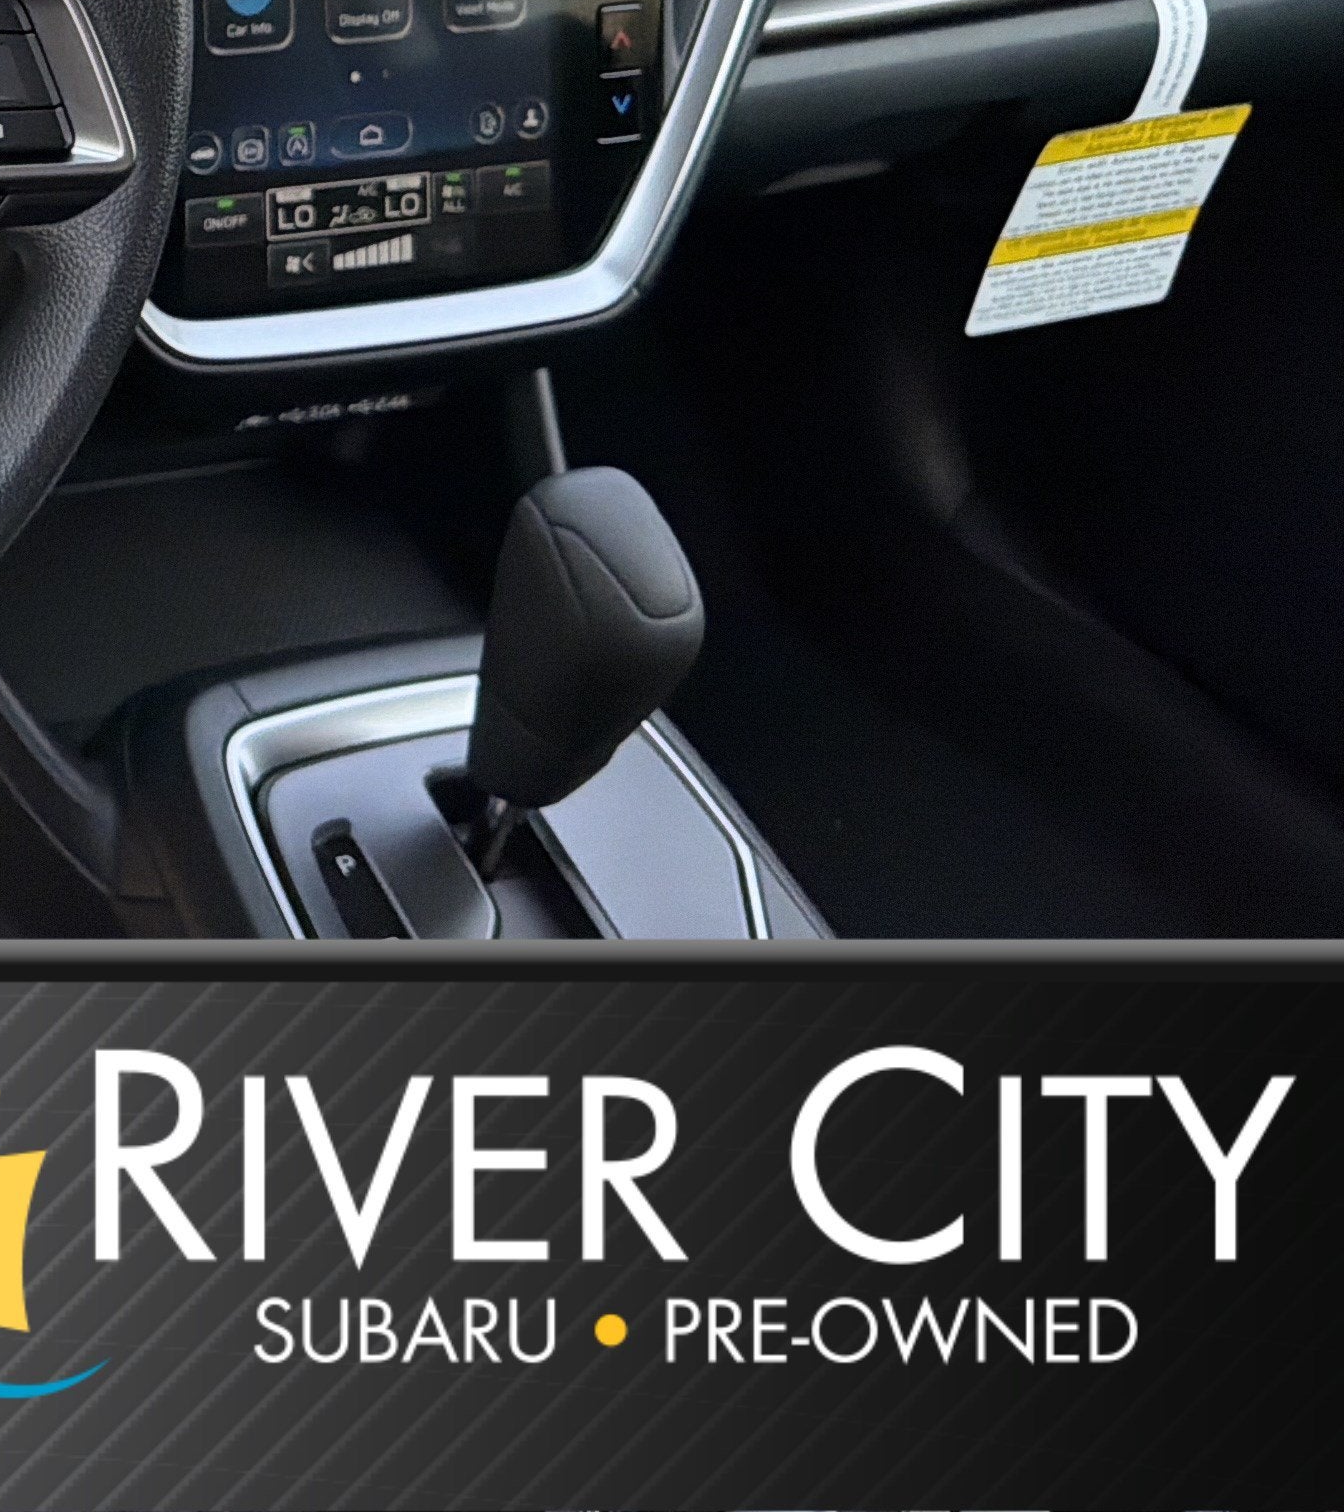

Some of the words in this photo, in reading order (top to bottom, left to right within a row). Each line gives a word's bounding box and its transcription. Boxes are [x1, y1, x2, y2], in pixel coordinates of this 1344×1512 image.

[338, 13, 379, 28] Display
[381, 9, 401, 24] Off
[226, 23, 248, 38] Car
[384, 192, 421, 219] LO
[203, 214, 248, 232] ON/OFF
[277, 204, 313, 230] LO
